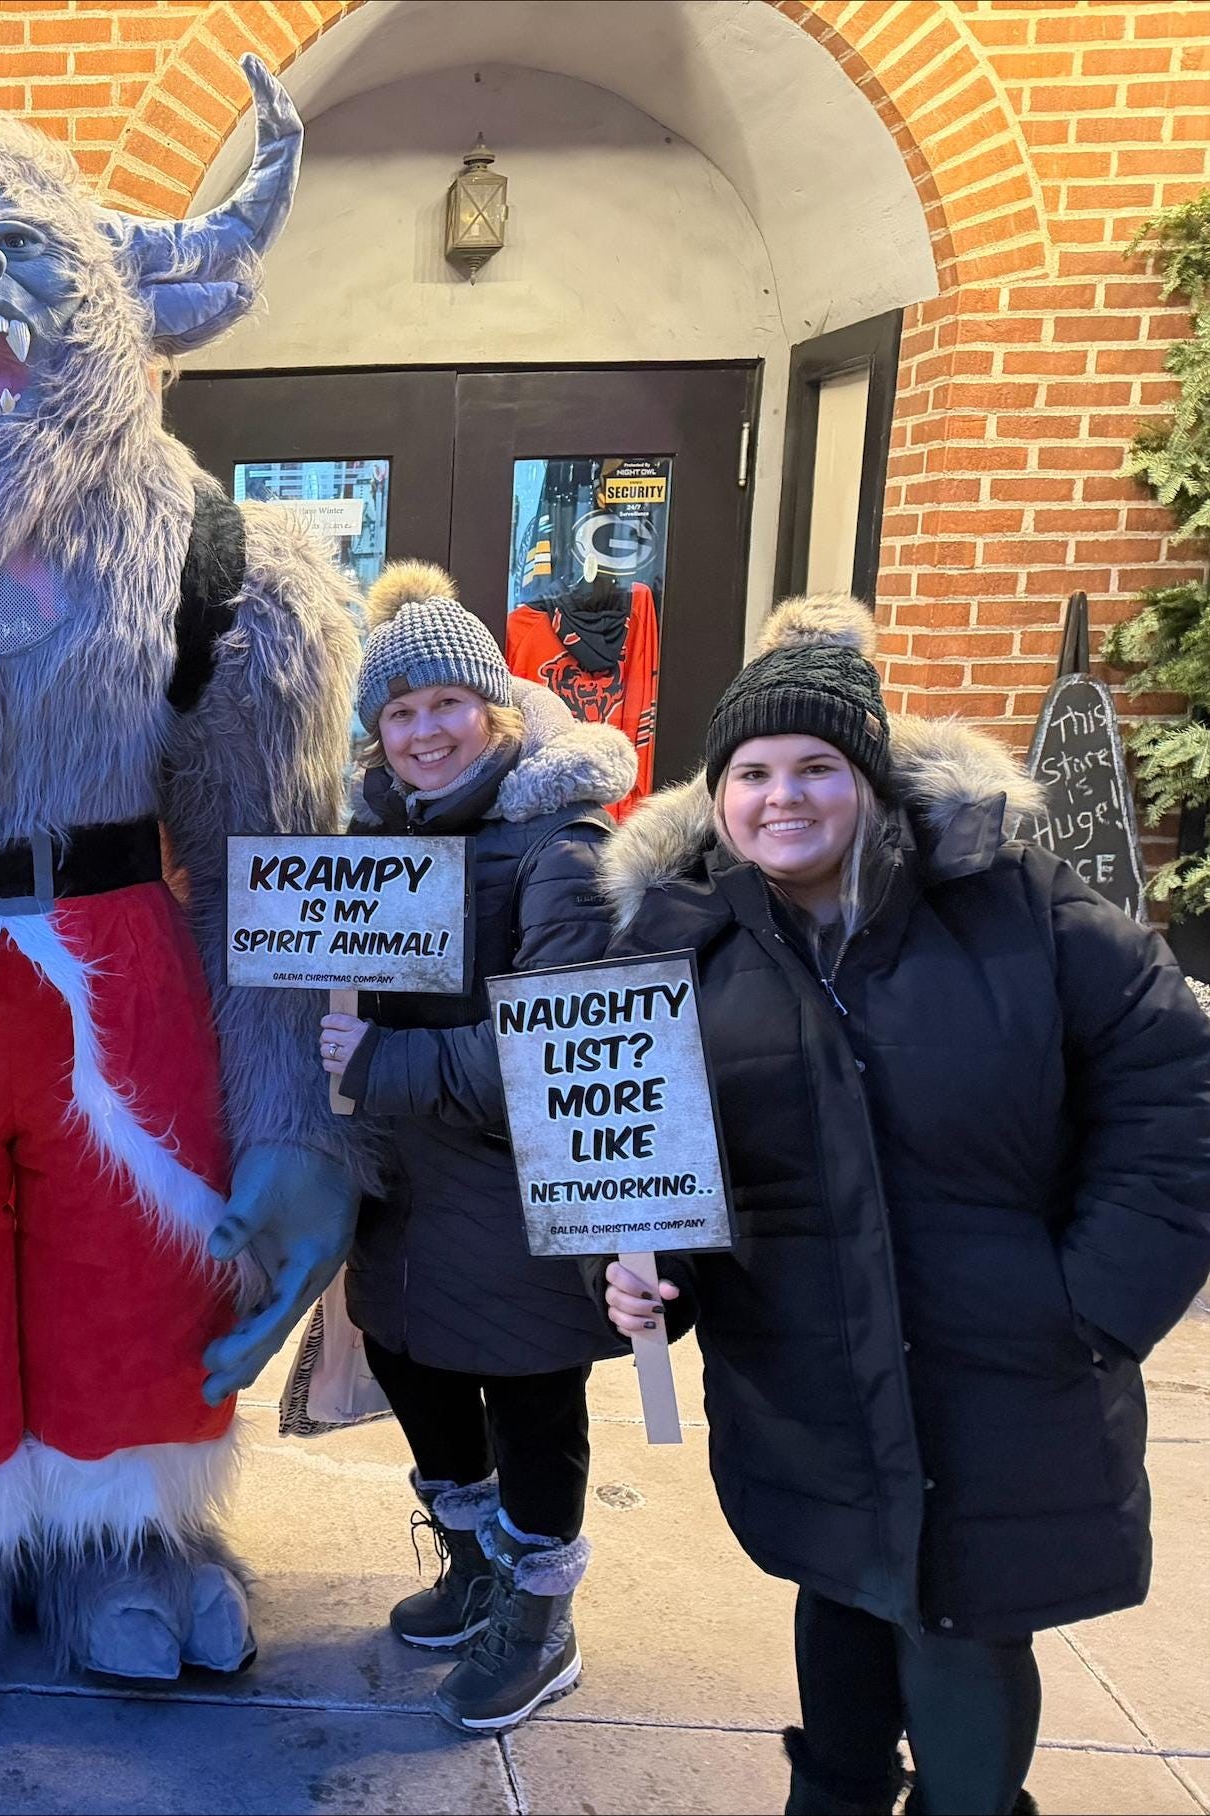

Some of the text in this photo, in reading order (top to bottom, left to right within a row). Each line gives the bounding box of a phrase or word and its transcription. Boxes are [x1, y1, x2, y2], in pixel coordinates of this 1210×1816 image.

[607, 486, 663, 499] SECURITY
[1050, 704, 1107, 744] This
[1041, 747, 1112, 786] Store
[1064, 777, 1093, 805] is
[1033, 779, 1124, 851] Huge!
[249, 855, 433, 893] KRAMPY
[300, 898, 379, 924] IS MY
[232, 928, 451, 957] SPIRIT ANIMAL!
[273, 973, 395, 984] GALENA CHRISTMAS COMPANY
[499, 982, 689, 1035] NAUGHTY
[544, 1032, 654, 1075] LIST?
[548, 1077, 666, 1120] MORE
[571, 1124, 655, 1163] LIKE
[530, 1173, 713, 1203] NETWORKING..
[550, 1219, 705, 1235] GALENA CHRISTMAS COMPANY
